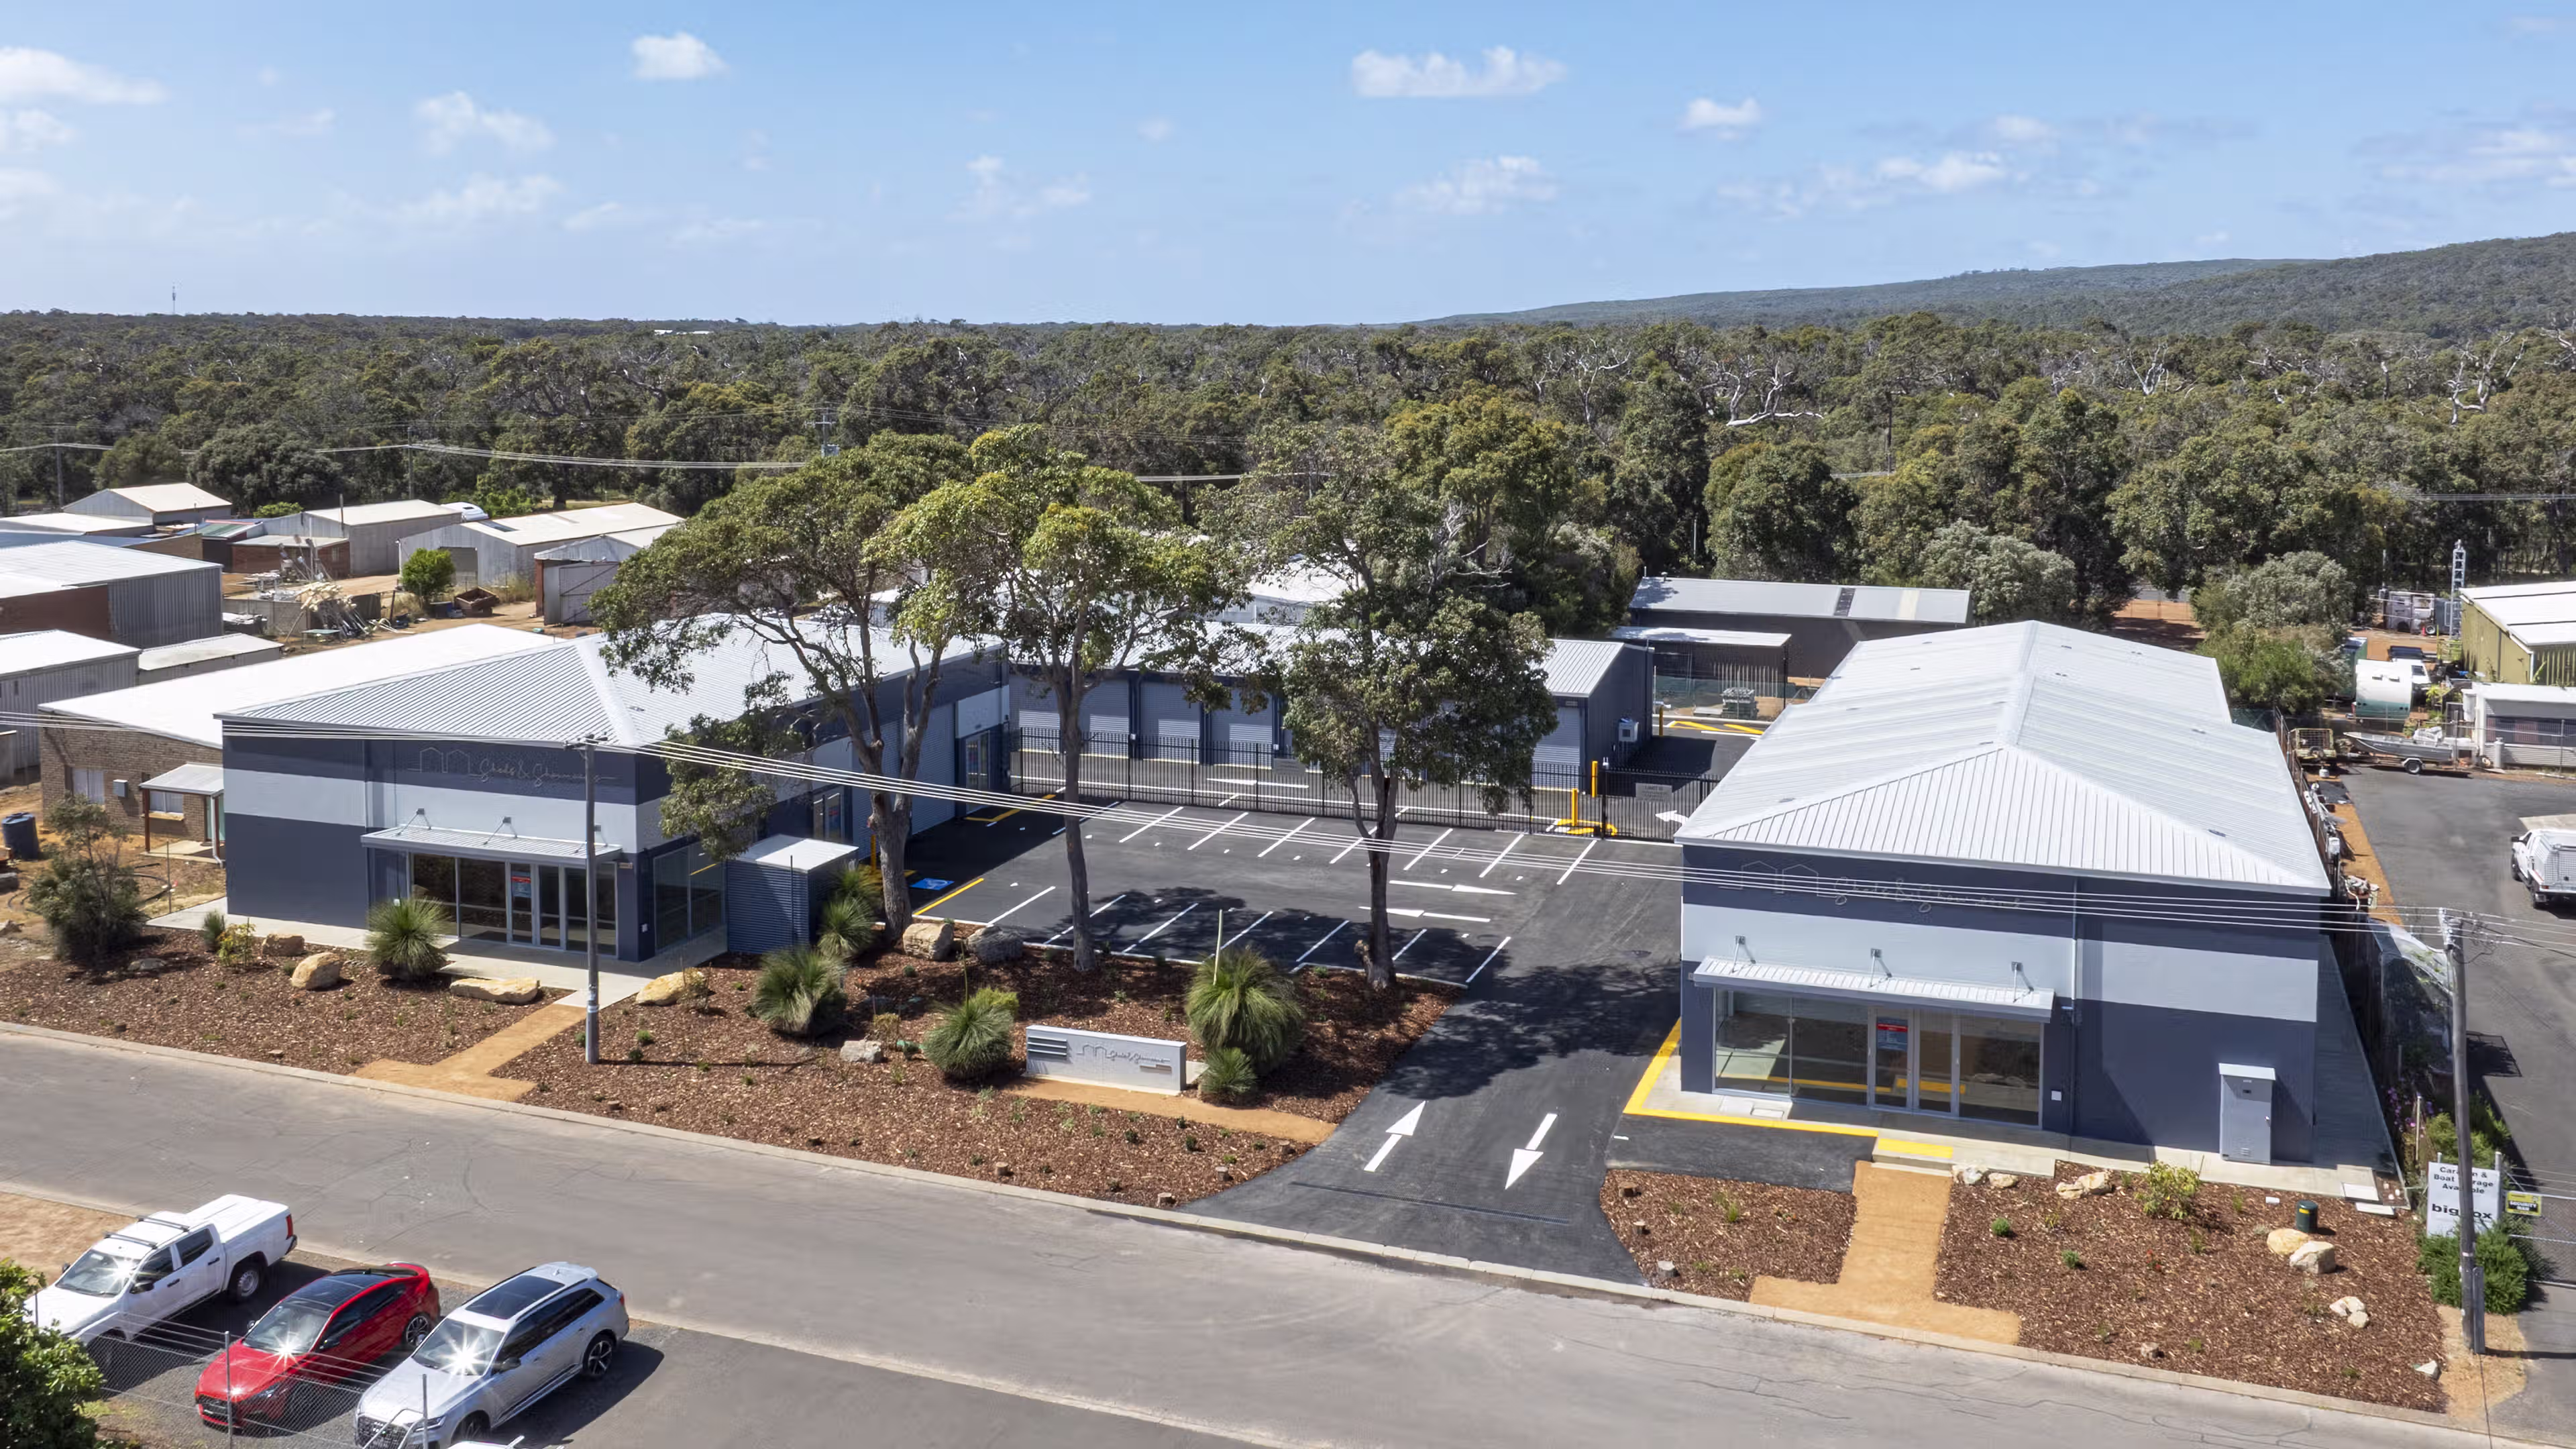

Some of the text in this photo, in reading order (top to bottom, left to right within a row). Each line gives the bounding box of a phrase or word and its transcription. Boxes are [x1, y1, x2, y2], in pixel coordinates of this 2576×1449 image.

[2439, 1167, 2478, 1176] Carn
[2434, 1174, 2455, 1182] Boat
[2432, 1203, 2492, 1220] bigox
